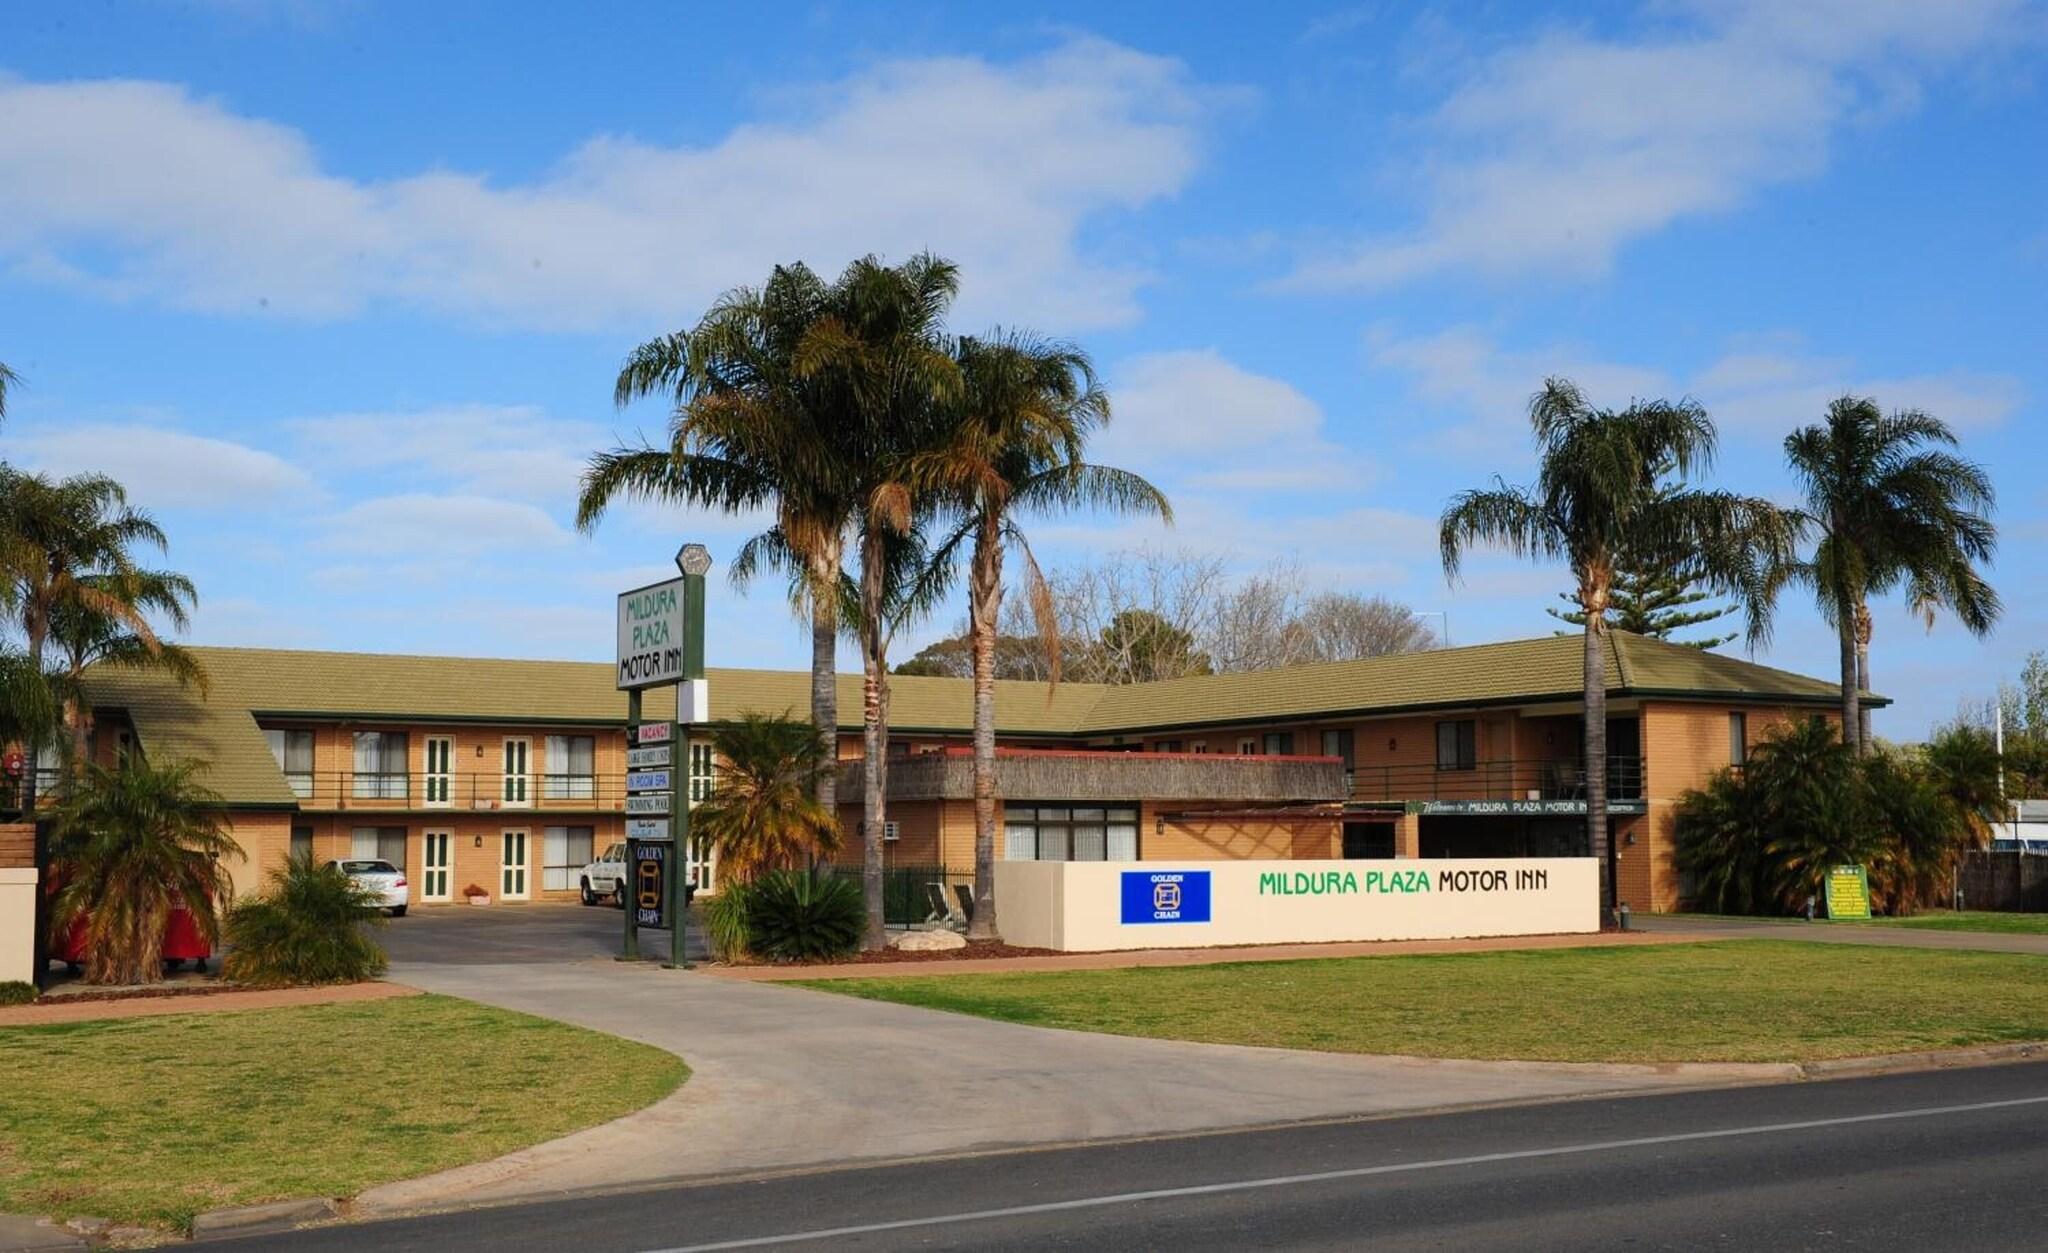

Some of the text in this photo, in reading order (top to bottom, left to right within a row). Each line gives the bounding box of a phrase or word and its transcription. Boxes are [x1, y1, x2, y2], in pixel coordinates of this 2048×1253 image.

[626, 589, 677, 623] MILDURA
[633, 620, 669, 650] PLAZA
[620, 647, 682, 681] MOTOR INN
[640, 725, 668, 739] VACANCY
[636, 775, 653, 787] ROOM
[655, 774, 667, 786] SPA
[1468, 802, 1508, 812] MILDURA
[1513, 802, 1541, 812] PLAZA
[1545, 802, 1575, 812] MOTOR
[1579, 802, 1588, 811] IN
[637, 847, 662, 859] GOLDEN
[1150, 874, 1184, 883] GOLDEN
[1259, 869, 1548, 895] MILDURA PLAZA MOTOR INN
[638, 909, 658, 923] CHAIN
[1153, 911, 1181, 919] CHAIN
